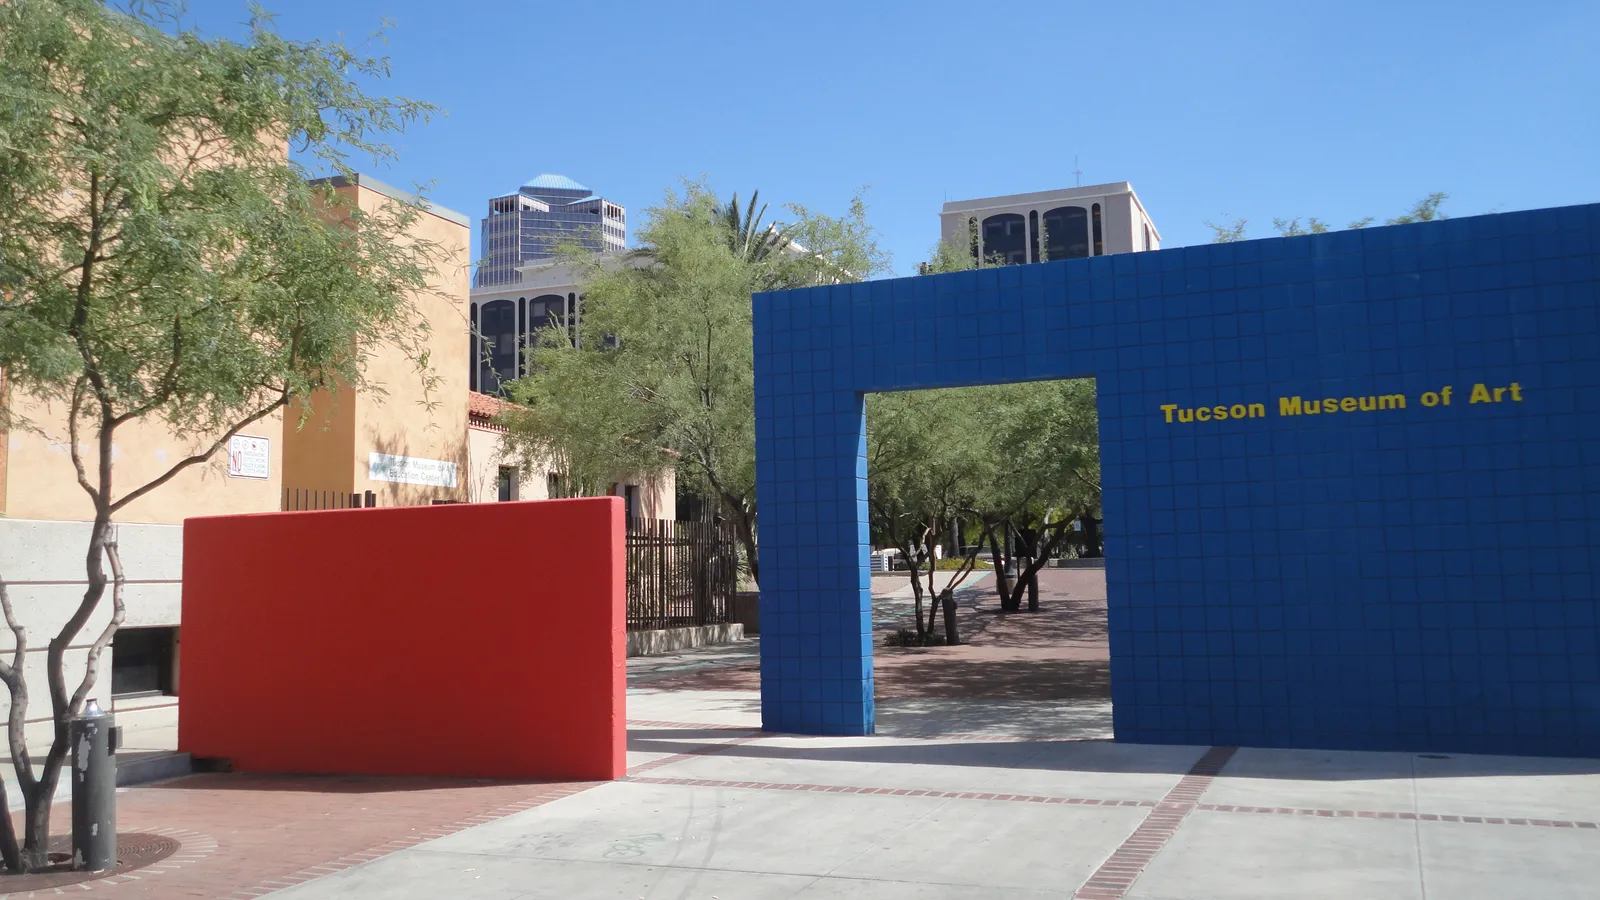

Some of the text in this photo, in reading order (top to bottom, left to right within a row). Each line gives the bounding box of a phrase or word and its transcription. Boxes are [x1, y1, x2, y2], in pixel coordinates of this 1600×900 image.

[1160, 382, 1523, 423] Tucson Museum of Art
[231, 450, 242, 472] NO
[389, 457, 410, 469] Tucson
[413, 460, 437, 471] Museum
[389, 468, 440, 483] Education Center
